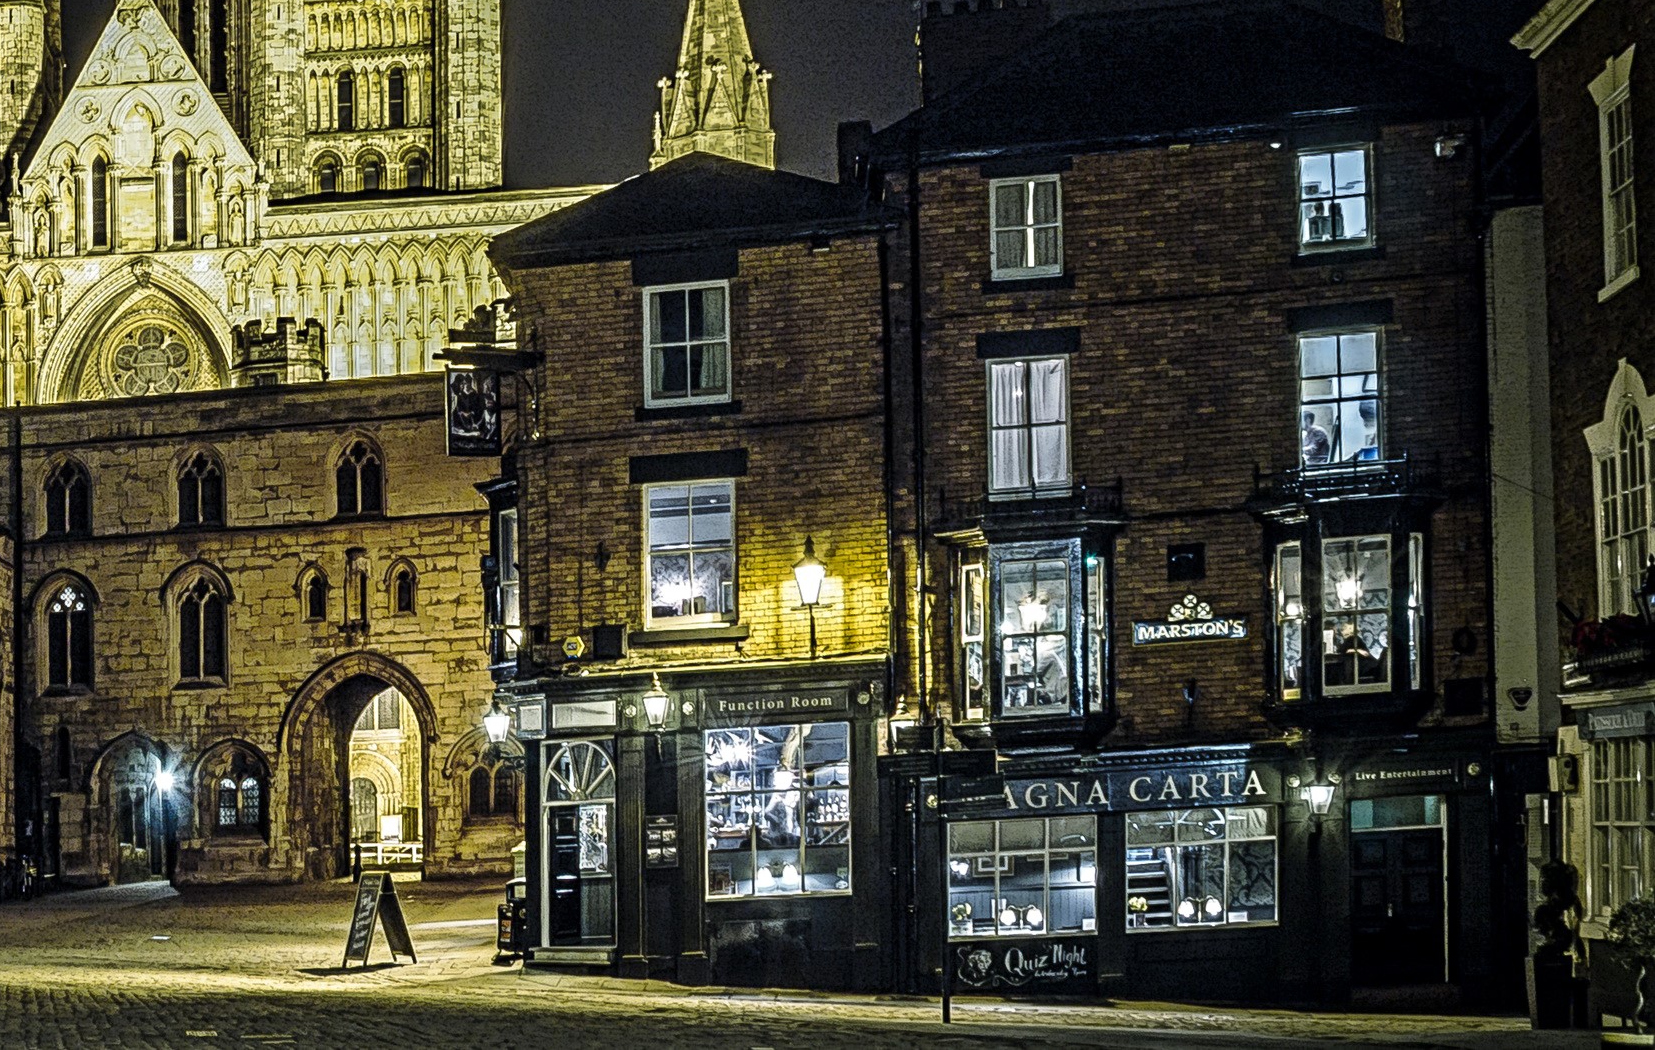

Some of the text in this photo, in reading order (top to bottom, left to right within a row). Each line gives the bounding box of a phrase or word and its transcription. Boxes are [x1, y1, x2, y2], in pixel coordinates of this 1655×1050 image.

[1138, 619, 1244, 640] MARSTON'S
[719, 696, 832, 712] Function Room
[1355, 768, 1451, 780] Live Entertainment
[1004, 770, 1267, 809] AGNA CARTA
[1005, 948, 1048, 977] Quiz
